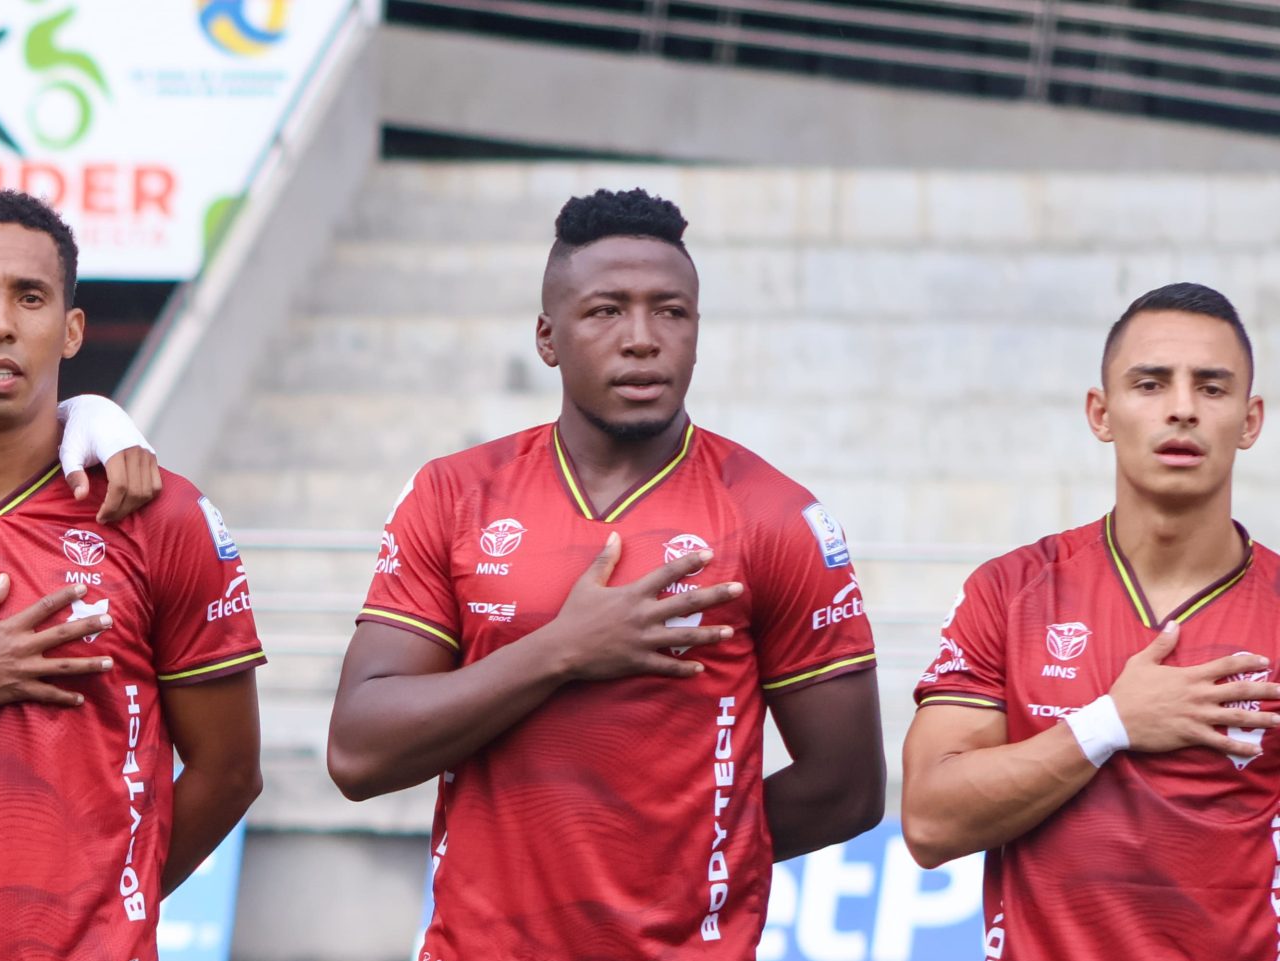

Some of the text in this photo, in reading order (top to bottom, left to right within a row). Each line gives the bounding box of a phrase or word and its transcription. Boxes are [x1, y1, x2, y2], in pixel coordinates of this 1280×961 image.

[476, 562, 510, 576] MNS
[65, 571, 102, 585] MNS
[207, 591, 251, 622] Elect
[467, 602, 516, 617] TOKE
[812, 597, 863, 630] Elect
[1041, 664, 1078, 680] MNS
[699, 696, 736, 942] BODYTECH
